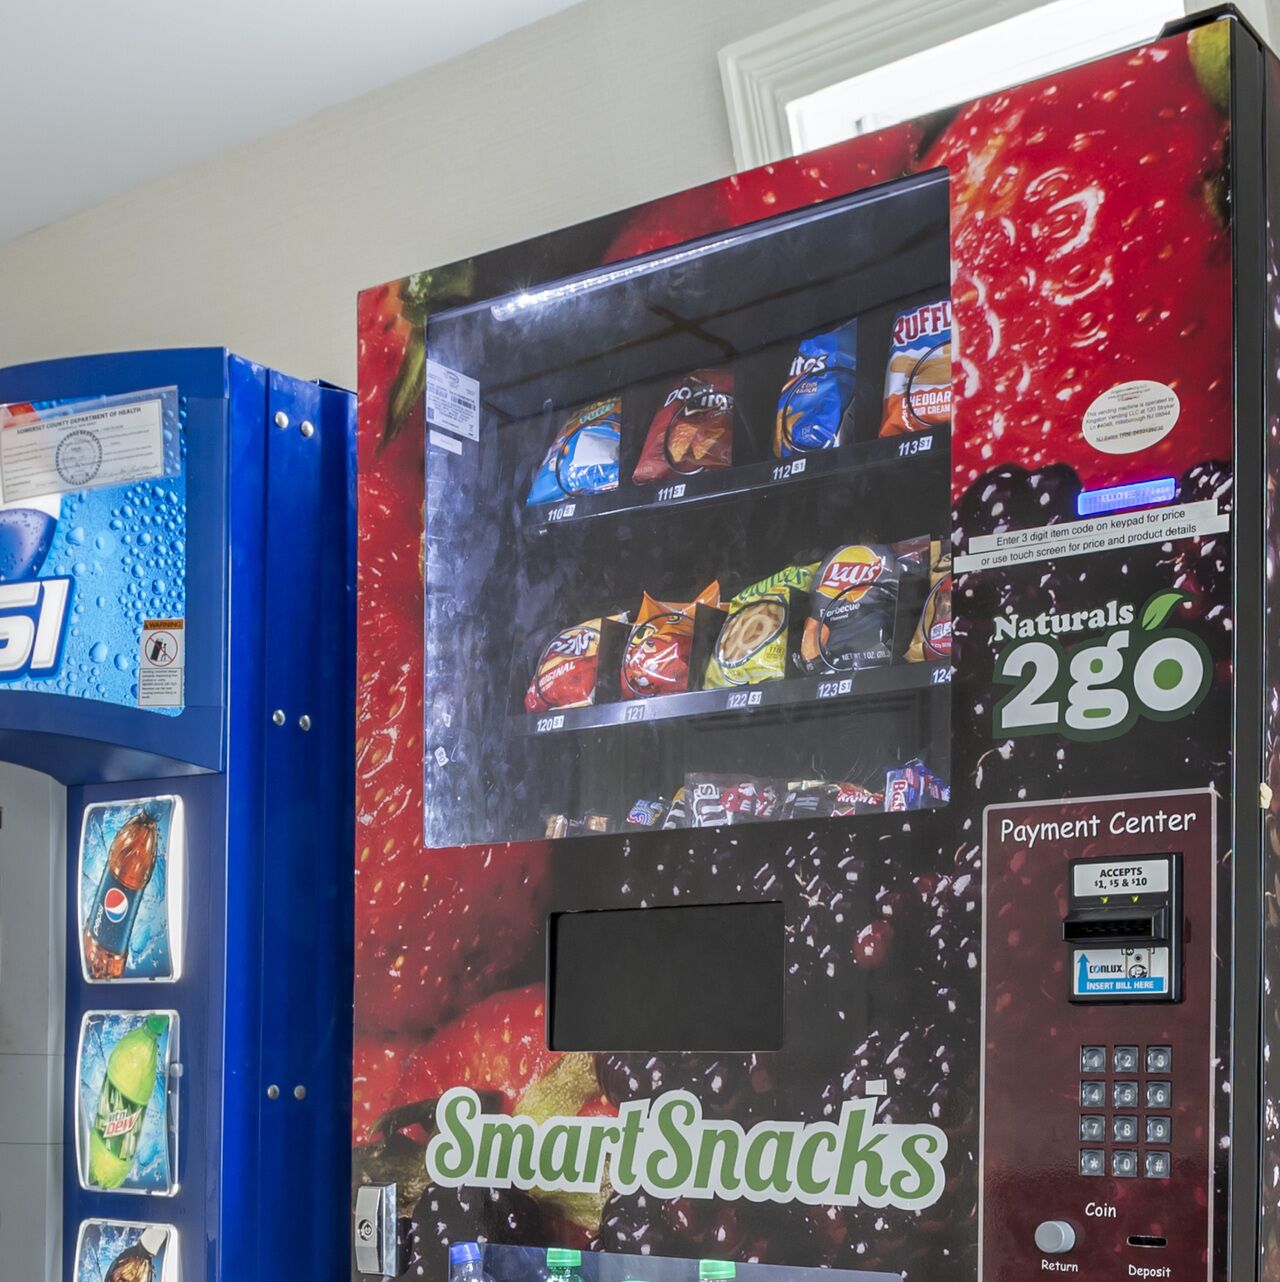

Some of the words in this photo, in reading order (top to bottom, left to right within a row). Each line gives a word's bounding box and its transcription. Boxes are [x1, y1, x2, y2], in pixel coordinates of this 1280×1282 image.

[70, 413, 109, 426] DEPARTMENT
[898, 440, 919, 456] 113
[772, 465, 791, 480] 112
[658, 486, 673, 501] 111
[547, 508, 563, 521] 110
[996, 534, 1020, 547] Enter
[1021, 532, 1028, 543] 3
[1030, 529, 1049, 542] digit
[1050, 527, 1070, 539] item
[1071, 524, 1094, 536] code
[1096, 523, 1108, 532] on
[1110, 515, 1145, 532] keypad
[1146, 513, 1161, 524] for
[1161, 509, 1186, 524] price
[981, 557, 991, 566] or
[992, 554, 1008, 564] use
[1009, 548, 1034, 561] touch
[1035, 545, 1067, 558] screen
[1068, 541, 1082, 552] for
[1082, 537, 1105, 553] price
[1107, 533, 1126, 546] and
[1127, 528, 1163, 546] product
[1164, 523, 1197, 537] details
[992, 600, 1135, 643] Naturals
[932, 668, 951, 683] 124
[1000, 630, 1204, 731] 2go
[818, 683, 838, 698] 123
[728, 694, 748, 708] 122
[626, 707, 644, 720] 121
[536, 718, 552, 732] 120
[999, 812, 1100, 848] Payment
[1108, 806, 1196, 837] Center
[1099, 866, 1143, 878] ACCEPTS
[1094, 880, 1107, 890] $1,
[1109, 878, 1119, 887] $5
[1121, 878, 1129, 887] &
[1131, 877, 1148, 887] $10
[1086, 981, 1114, 990] INSERT
[1115, 980, 1132, 990] BILL
[1133, 980, 1154, 989] HERE
[1124, 1055, 1132, 1067] 2
[1157, 1055, 1164, 1067] 3
[1091, 1089, 1100, 1100] 4
[1124, 1089, 1131, 1101] 5
[1156, 1090, 1164, 1102] 6
[1091, 1123, 1099, 1135] 7
[1123, 1124, 1131, 1136] 8
[1156, 1124, 1164, 1137] 9
[433, 1093, 940, 1201] SmartSnacks
[1123, 1159, 1131, 1171] 0
[1084, 1202, 1117, 1218] Coin
[1041, 1259, 1079, 1272] Return
[1128, 1264, 1171, 1279] Deposit
